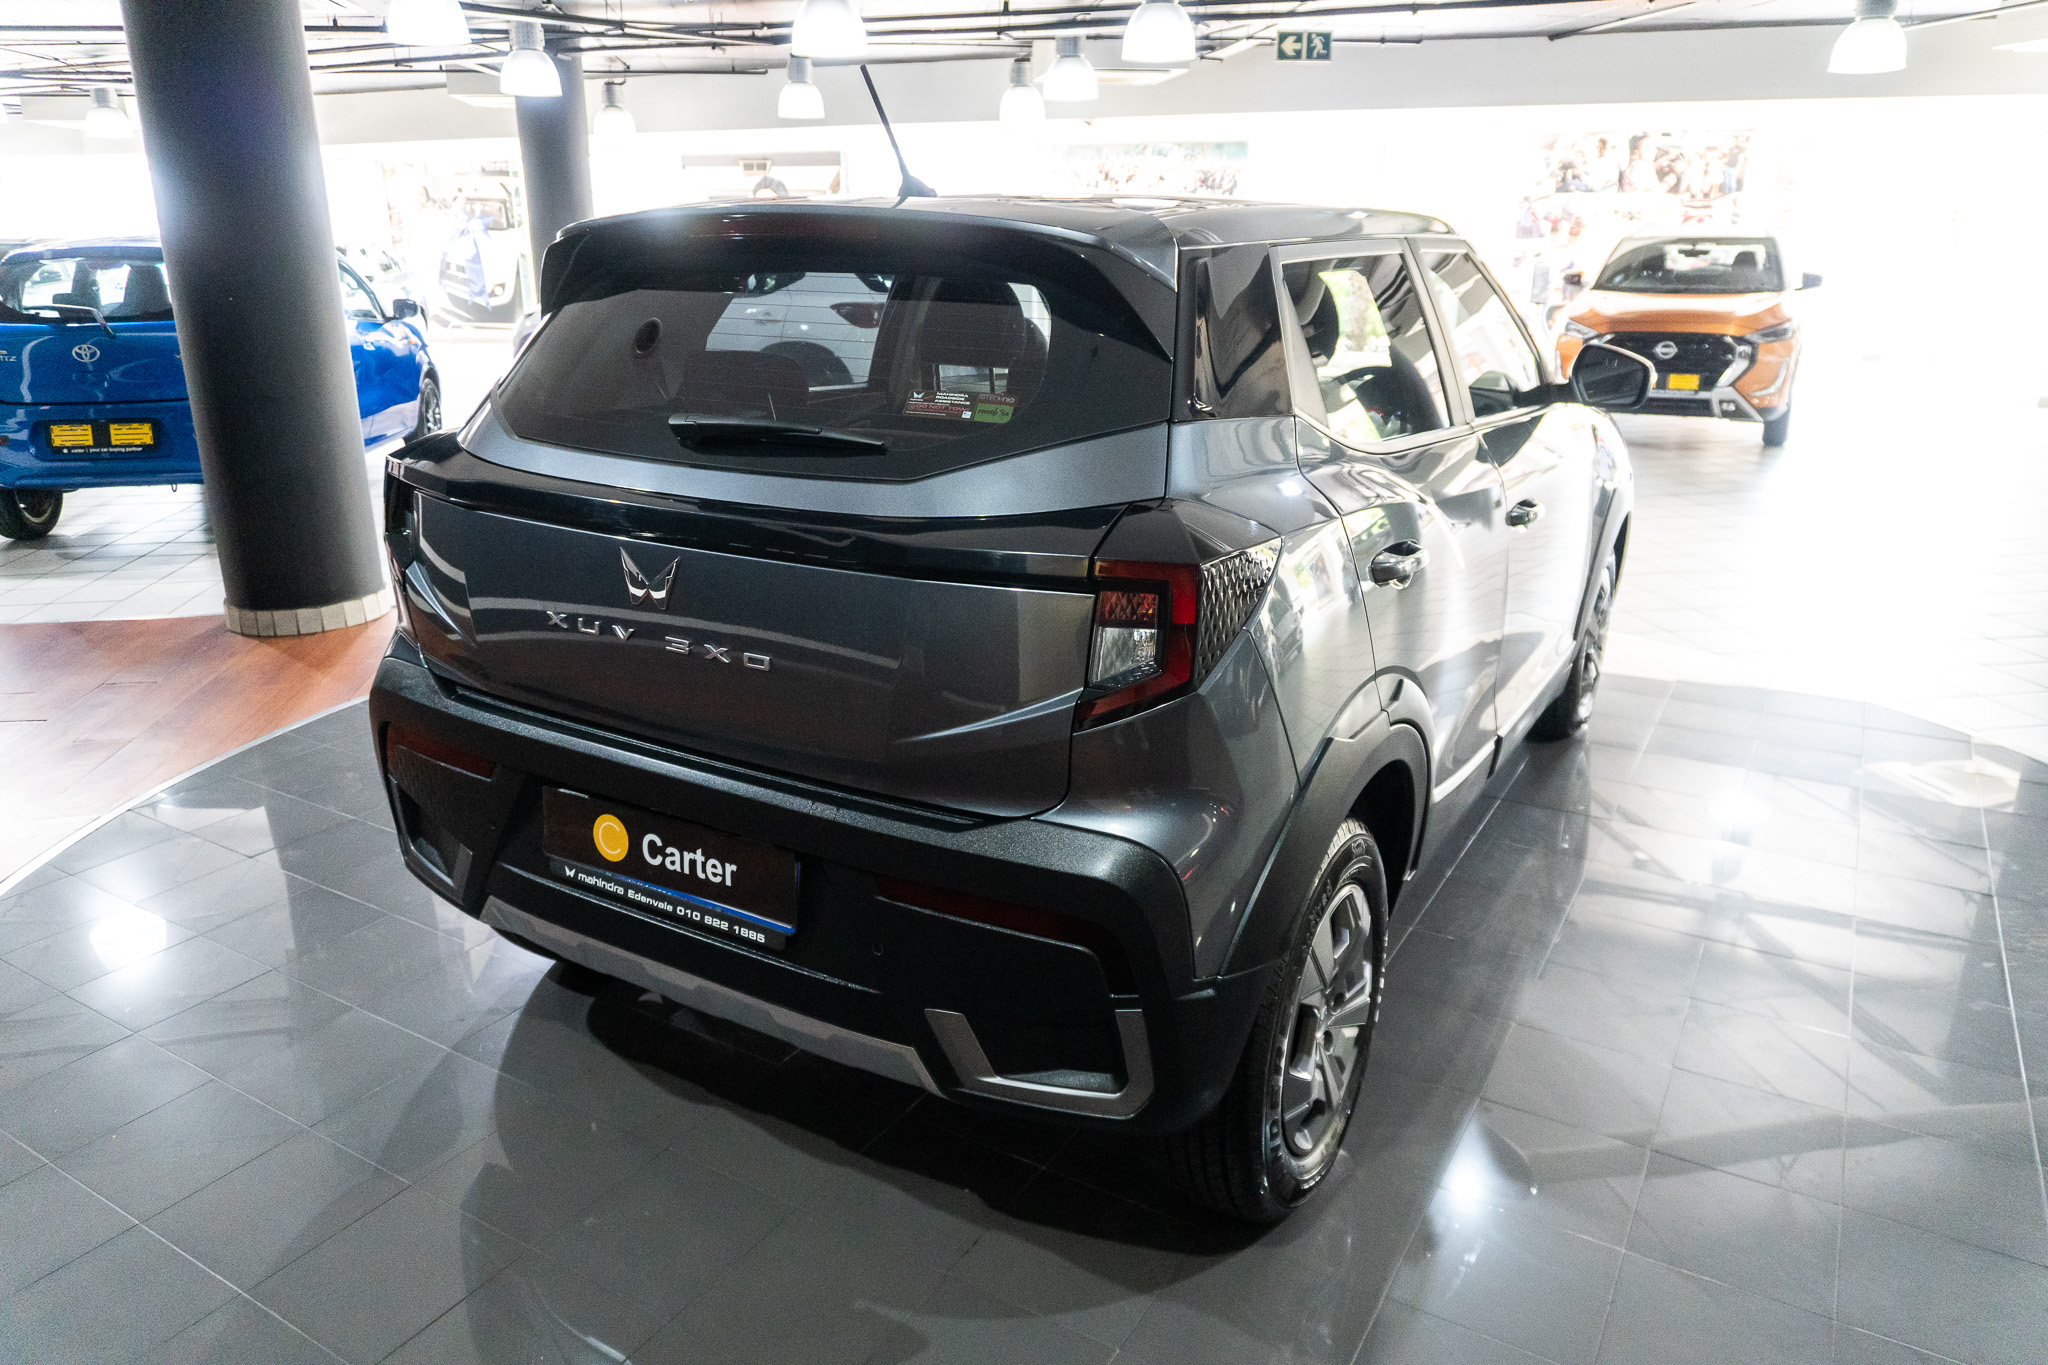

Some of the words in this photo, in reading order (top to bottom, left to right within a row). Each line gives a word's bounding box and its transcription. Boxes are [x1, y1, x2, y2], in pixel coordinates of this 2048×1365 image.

[546, 610, 635, 641] XUV
[665, 636, 771, 672] 3XO
[641, 833, 738, 887] Carter
[577, 871, 625, 896] mahindra
[627, 889, 674, 912] Edenvale
[676, 906, 701, 921] 010
[704, 915, 729, 931] 822
[732, 924, 766, 944] 1885
